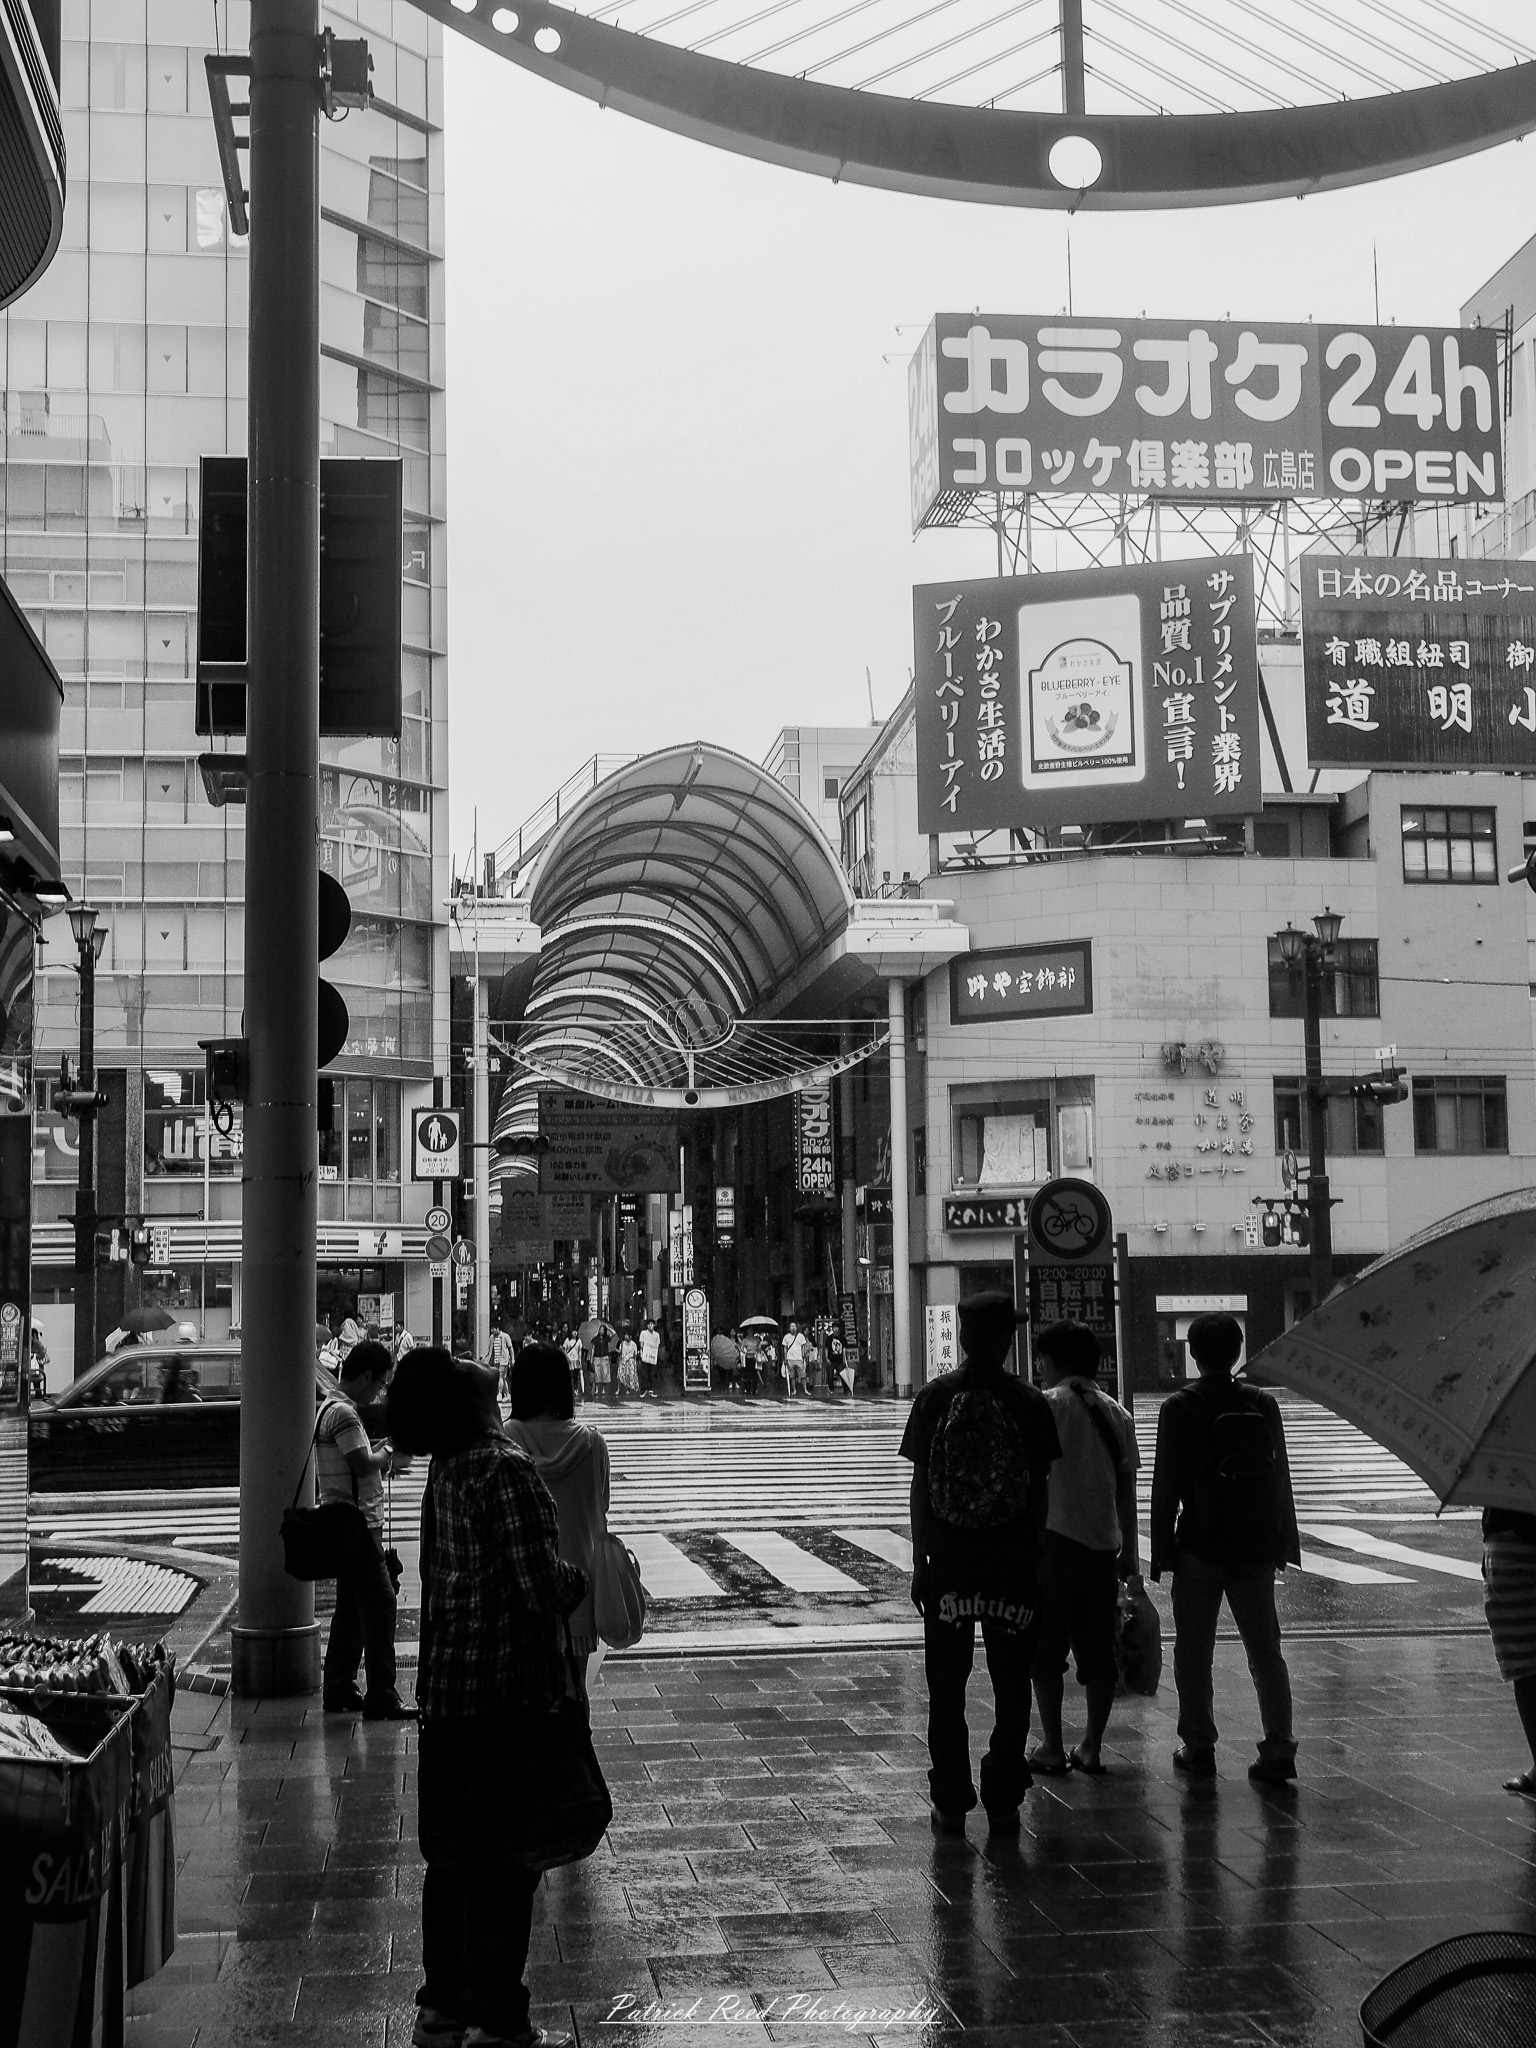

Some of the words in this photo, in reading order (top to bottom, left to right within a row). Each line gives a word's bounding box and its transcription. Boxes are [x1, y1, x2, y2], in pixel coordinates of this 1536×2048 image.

[941, 325, 1309, 423] カラオケ
[1325, 331, 1493, 433] 24h
[952, 437, 1254, 490] コロッケ倶楽部
[1262, 447, 1316, 491] 広島店
[1329, 446, 1496, 496] OPEN
[1317, 567, 1535, 602] 日本の名品コーナー
[1324, 635, 1470, 670] 有職組紐司
[975, 616, 1008, 782] わかさ生活の
[1206, 569, 1243, 796] サプリメント業界
[935, 593, 964, 813] ブルーベリーアイ
[966, 966, 1076, 1001] 叶や宝飾部
[802, 1157, 832, 1173] 24h
[802, 1173, 832, 1189] OPEN
[431, 1214, 446, 1227] 20
[1040, 1280, 1104, 1300] 自転車
[1040, 1300, 1105, 1321] 通行止
[939, 1310, 952, 1359] 振袖展
